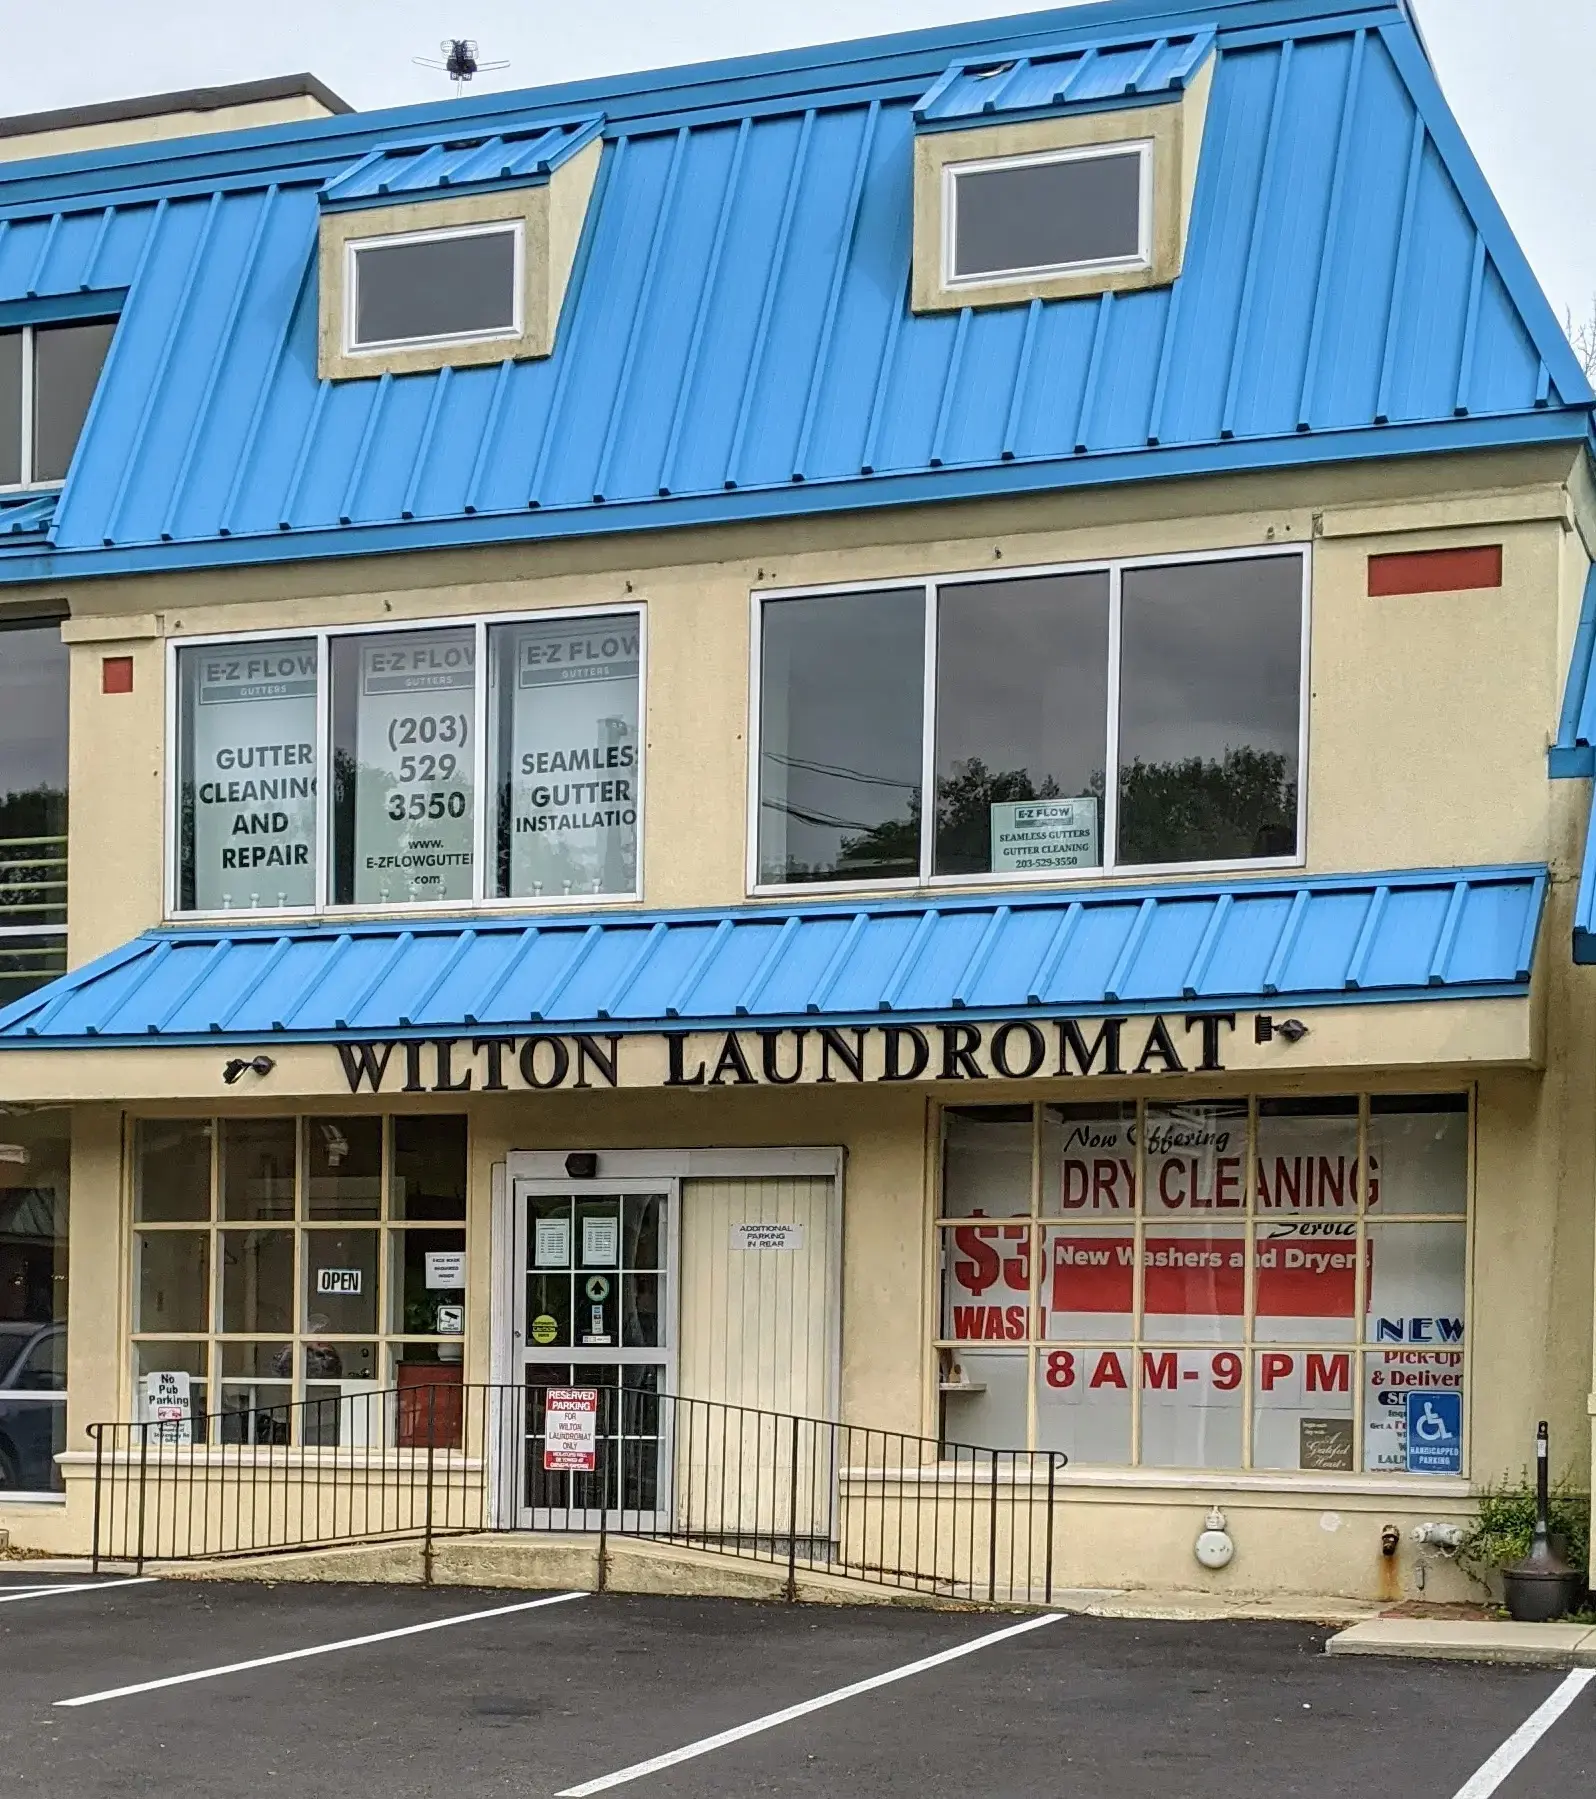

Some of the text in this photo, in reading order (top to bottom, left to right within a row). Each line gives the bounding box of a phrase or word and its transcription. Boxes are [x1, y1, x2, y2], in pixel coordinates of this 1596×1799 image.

[371, 653, 405, 672] E-Z
[527, 645, 562, 665] E-Z
[207, 661, 240, 682] E-Z
[562, 667, 610, 678] GUTTERS
[240, 685, 287, 696] GUTTERS
[405, 676, 453, 687] GUTTERS
[388, 714, 468, 752] (203)
[216, 744, 313, 770] GUTTER
[521, 746, 638, 775] SEAMLES
[400, 754, 456, 782] 529
[531, 780, 631, 808] GUTTER
[388, 792, 466, 821] 3550
[1018, 808, 1070, 818] E-Z FLOW
[232, 812, 289, 836] AND
[516, 810, 637, 833] INSTALLATIO
[408, 839, 444, 849] www.
[1000, 829, 1090, 842] SEAMLESS GUTTERS
[222, 844, 309, 869] REPAIR
[1003, 843, 1089, 856] GUTTER CLEANING
[1016, 857, 1078, 868] 203-529-3550
[410, 875, 441, 885] .com
[335, 1012, 1236, 1094] WILTON LAUNDROMAT
[1064, 1126, 1117, 1152] Now
[1063, 1156, 1379, 1208] DRY CLEANING
[1268, 1212, 1357, 1239] Servic
[955, 1209, 1047, 1296] $3
[1056, 1246, 1110, 1265] New
[322, 1272, 358, 1290] OPEN
[1377, 1318, 1464, 1342] NEW
[161, 1374, 174, 1384] No
[1372, 1370, 1464, 1386] & Deliver
[159, 1385, 178, 1394] Pub
[549, 1391, 594, 1400] RESERVED
[149, 1395, 188, 1407] Parking
[552, 1402, 590, 1410] PARKING
[565, 1412, 576, 1420] FOR
[1419, 1456, 1450, 1464] PARKING
